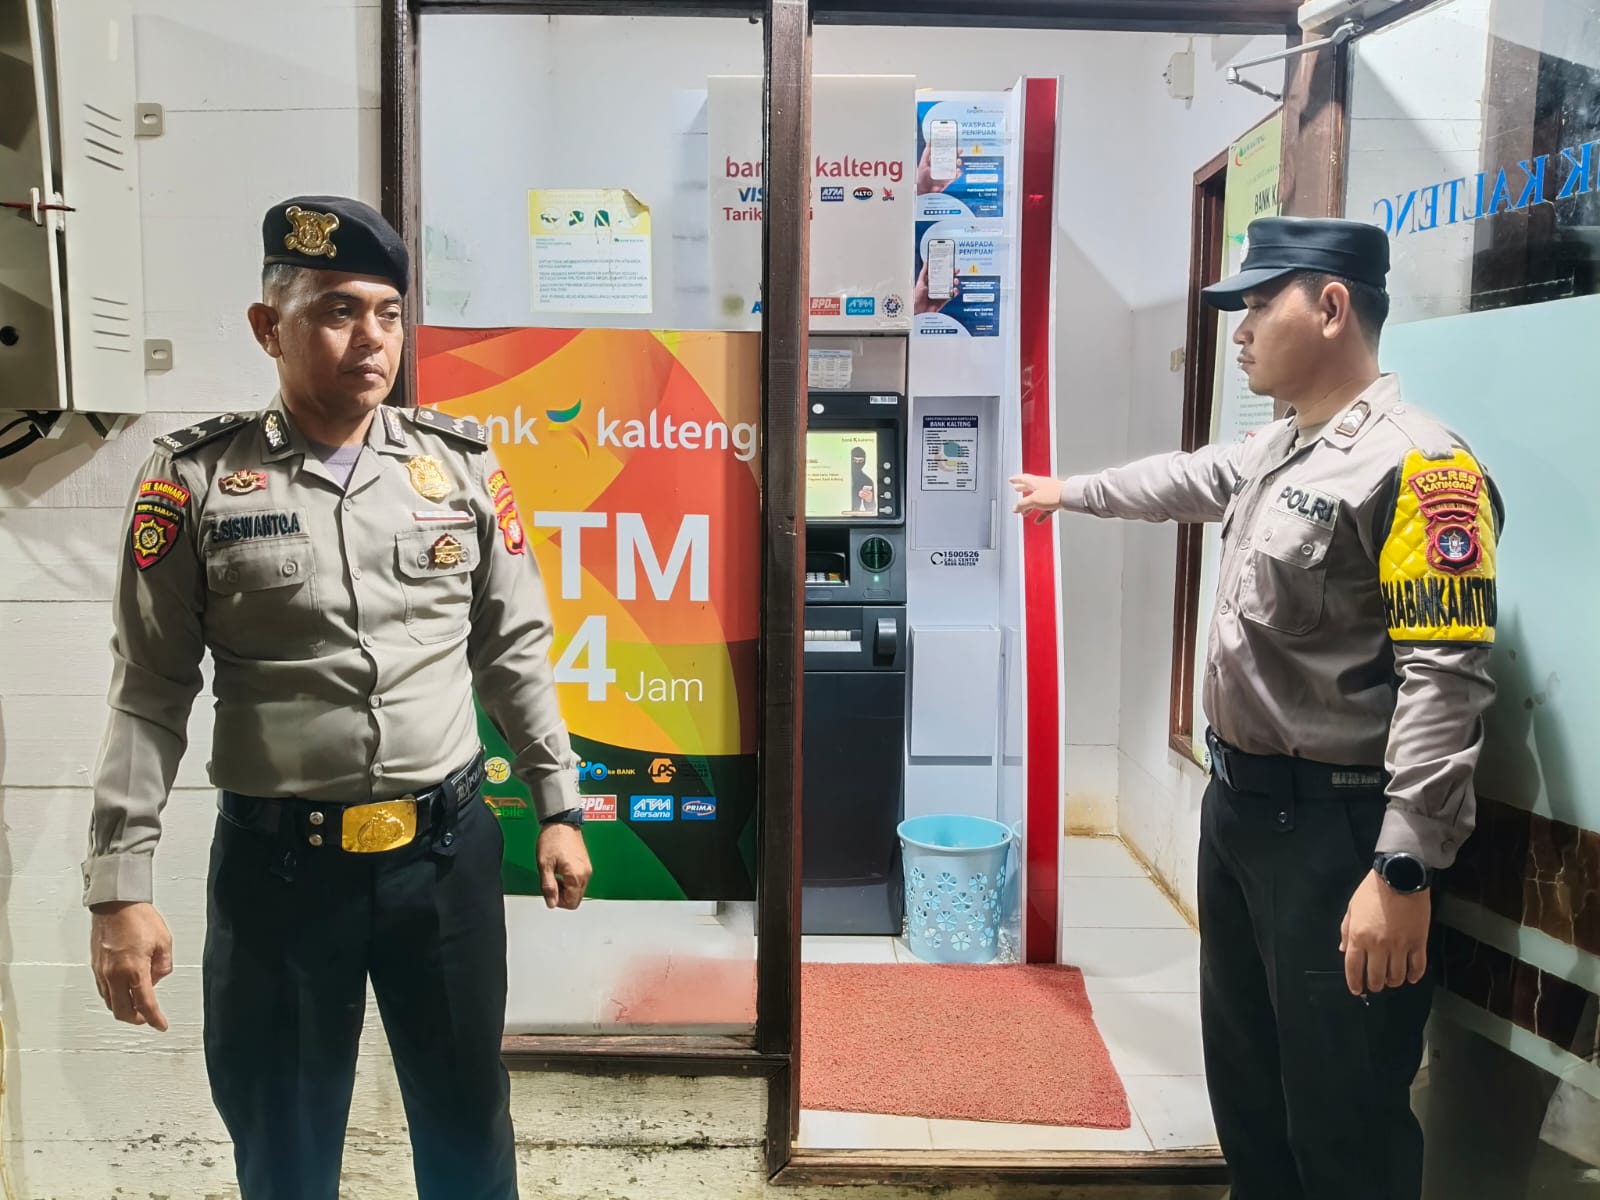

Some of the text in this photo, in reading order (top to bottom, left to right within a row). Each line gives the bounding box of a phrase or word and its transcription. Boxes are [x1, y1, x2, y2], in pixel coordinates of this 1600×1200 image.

[815, 156, 903, 182] kalteng
[723, 207, 762, 221] Tarik
[1254, 187, 1271, 215] BANK
[597, 407, 758, 463] kalteng
[1415, 470, 1478, 489] POLRES
[1276, 486, 1335, 523] POLRI
[534, 511, 710, 602] TM
[553, 615, 617, 703] 4
[625, 672, 704, 703] Jam
[649, 763, 677, 777] LPS
[633, 798, 672, 811] ATM
[633, 810, 671, 818] Bersama
[686, 804, 712, 812] PRIMA
